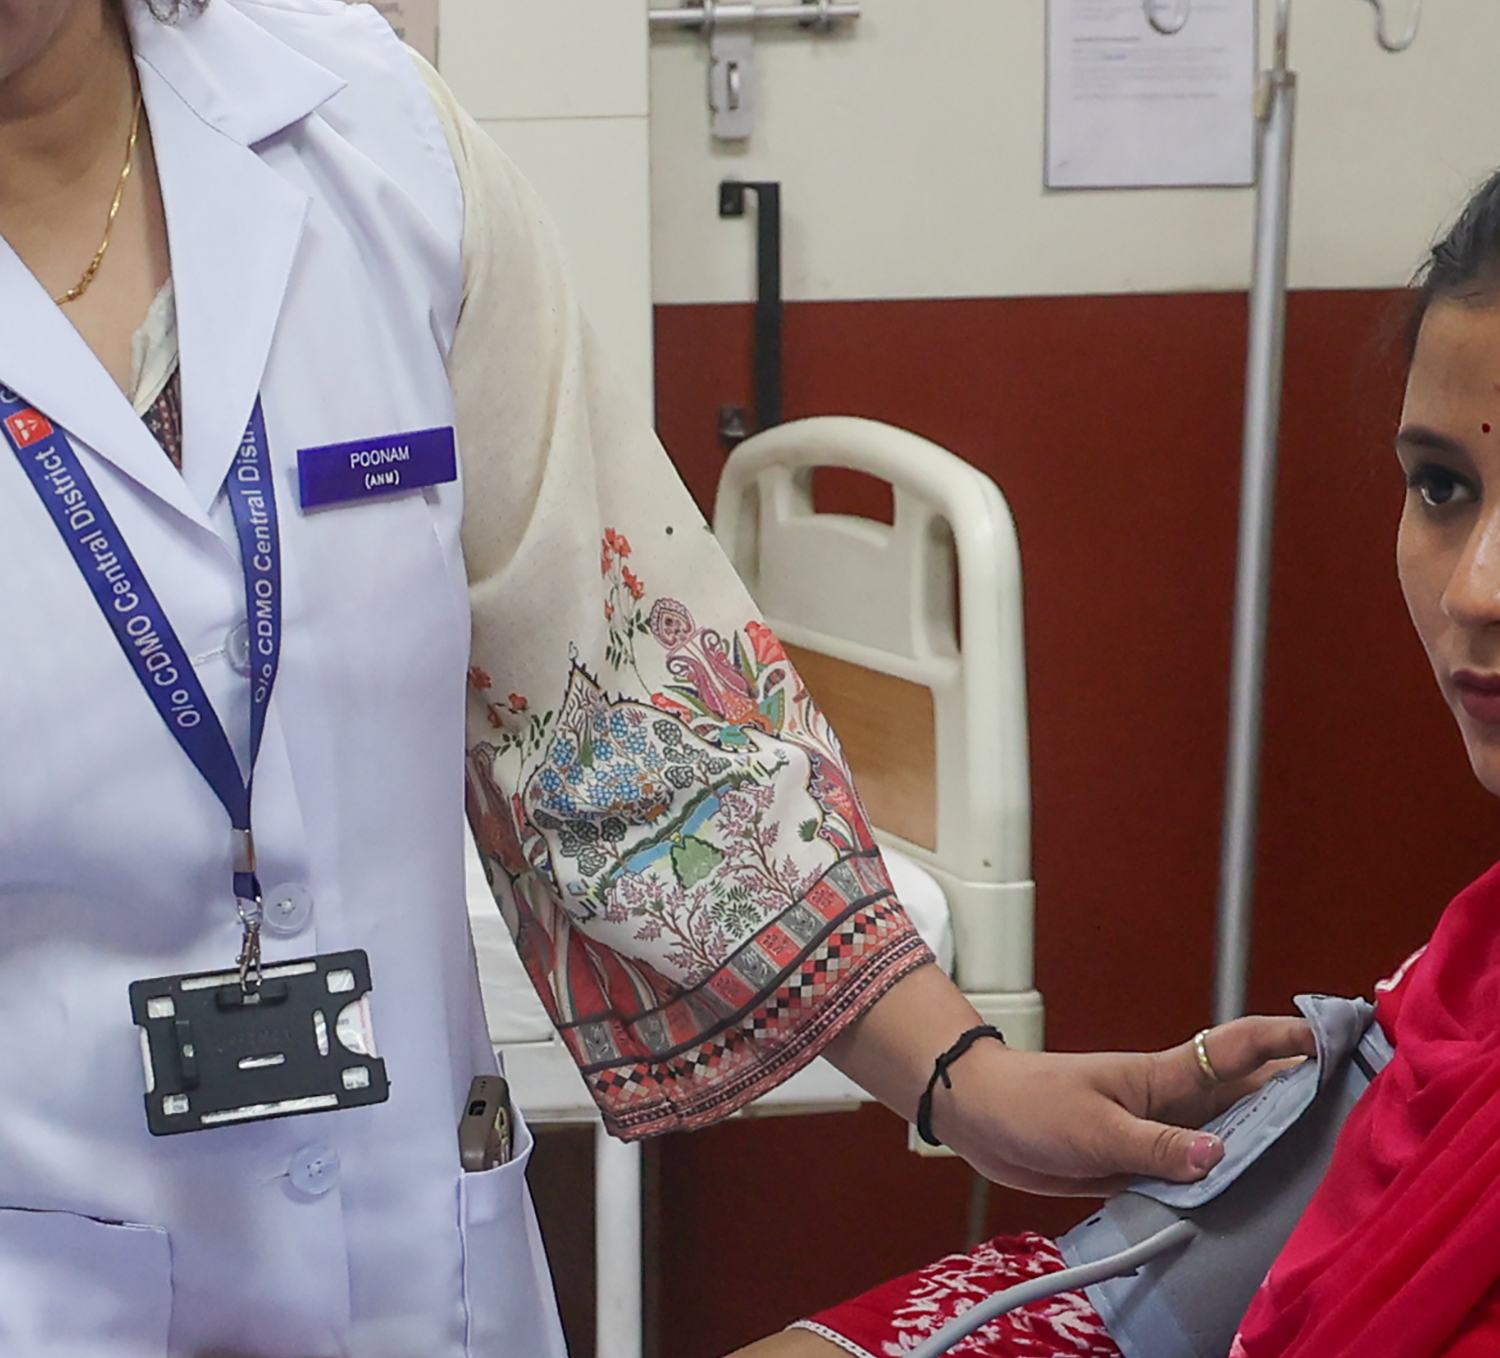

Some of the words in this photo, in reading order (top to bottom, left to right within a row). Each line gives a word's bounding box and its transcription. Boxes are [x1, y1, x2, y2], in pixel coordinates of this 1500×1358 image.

[34, 445, 96, 531] District
[350, 445, 410, 469] POONAM
[365, 469, 400, 490] (ANM)
[240, 488, 273, 572] Central
[80, 529, 140, 614] Central
[126, 614, 179, 688] CDMO
[255, 578, 274, 657] CDMO
